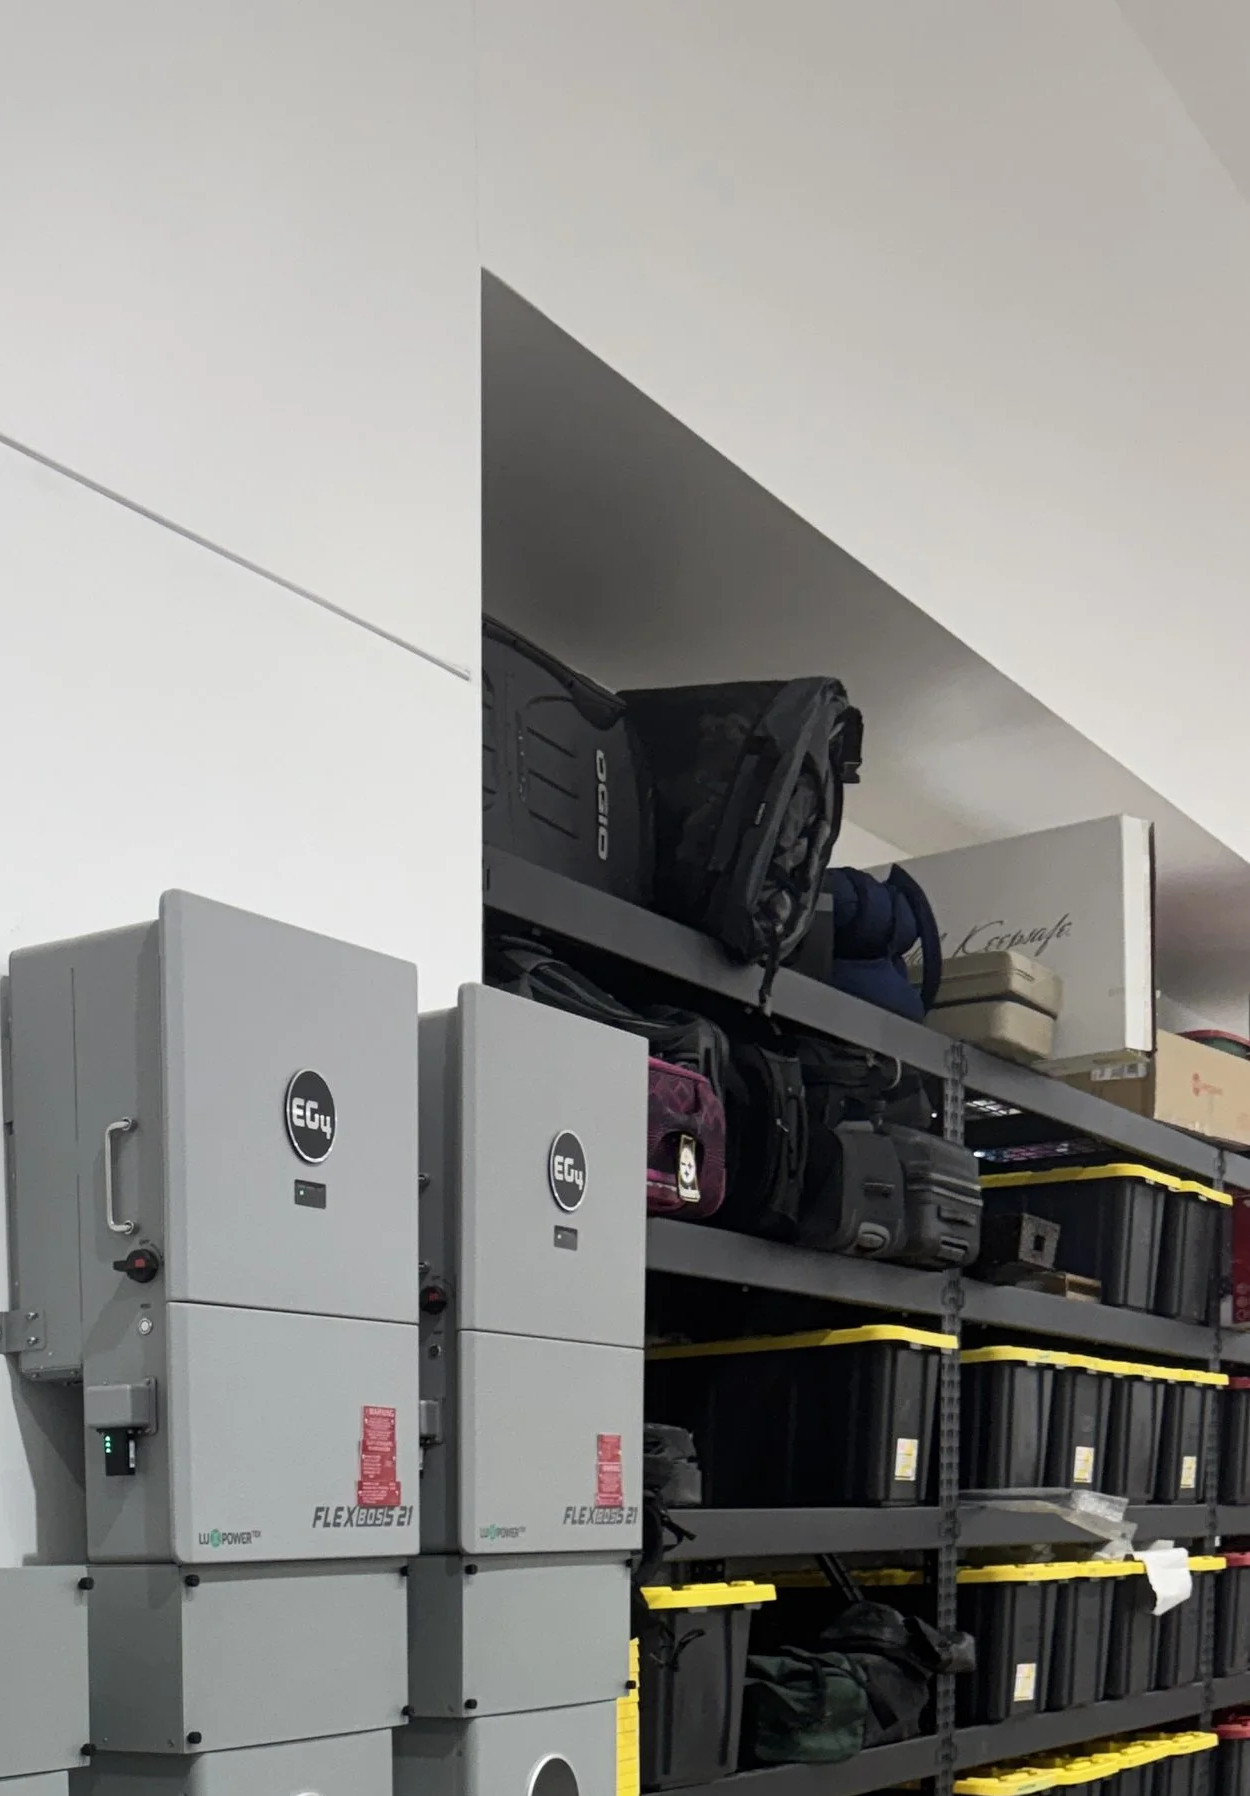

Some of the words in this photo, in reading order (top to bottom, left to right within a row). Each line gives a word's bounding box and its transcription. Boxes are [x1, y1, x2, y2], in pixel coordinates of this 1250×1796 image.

[596, 749, 609, 861] OGIO
[291, 1096, 333, 1140] EG4
[554, 1154, 584, 1191] EG4
[396, 1504, 413, 1527] 21
